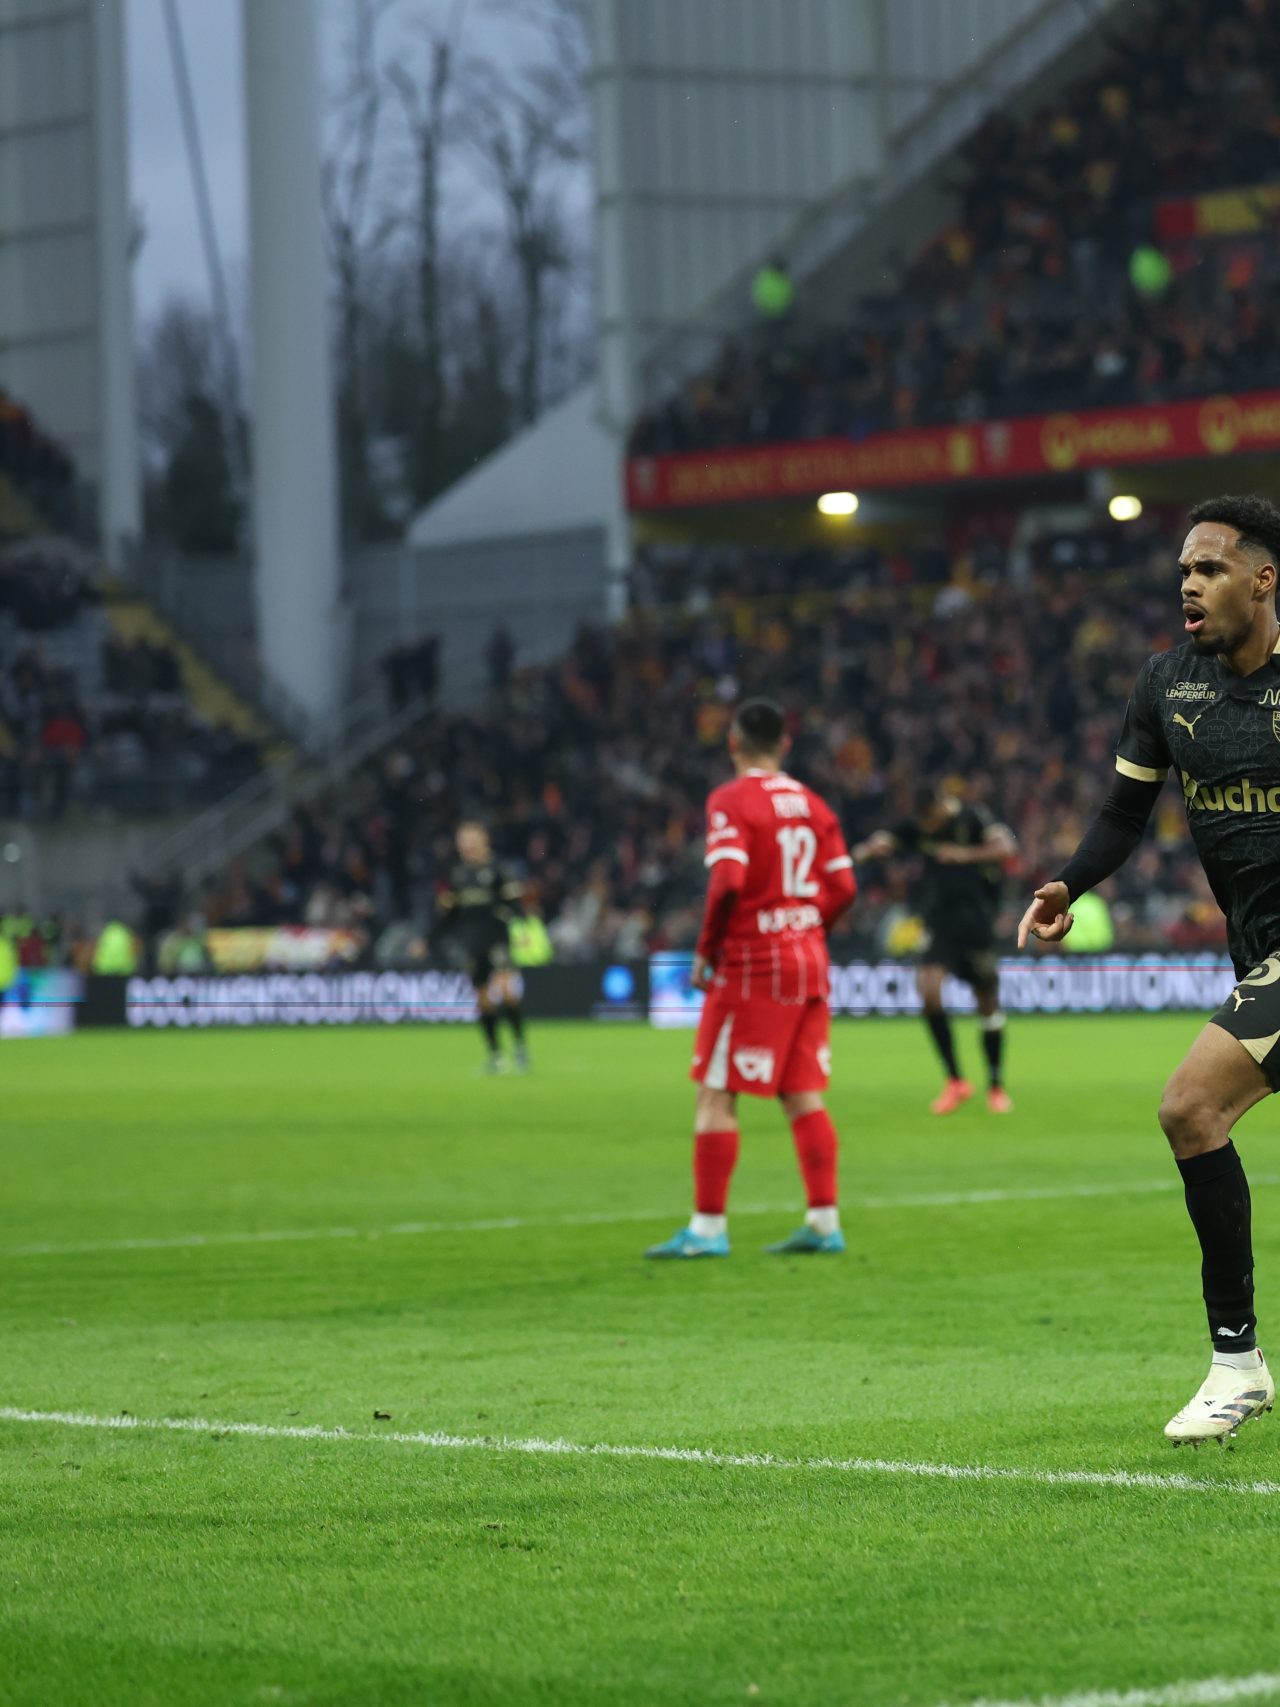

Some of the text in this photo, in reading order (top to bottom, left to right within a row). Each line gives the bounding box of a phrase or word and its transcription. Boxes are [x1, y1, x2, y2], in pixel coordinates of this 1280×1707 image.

[1176, 681, 1209, 691] GROUPE
[1165, 688, 1216, 700] LEMPEREUR
[775, 825, 820, 898] 12
